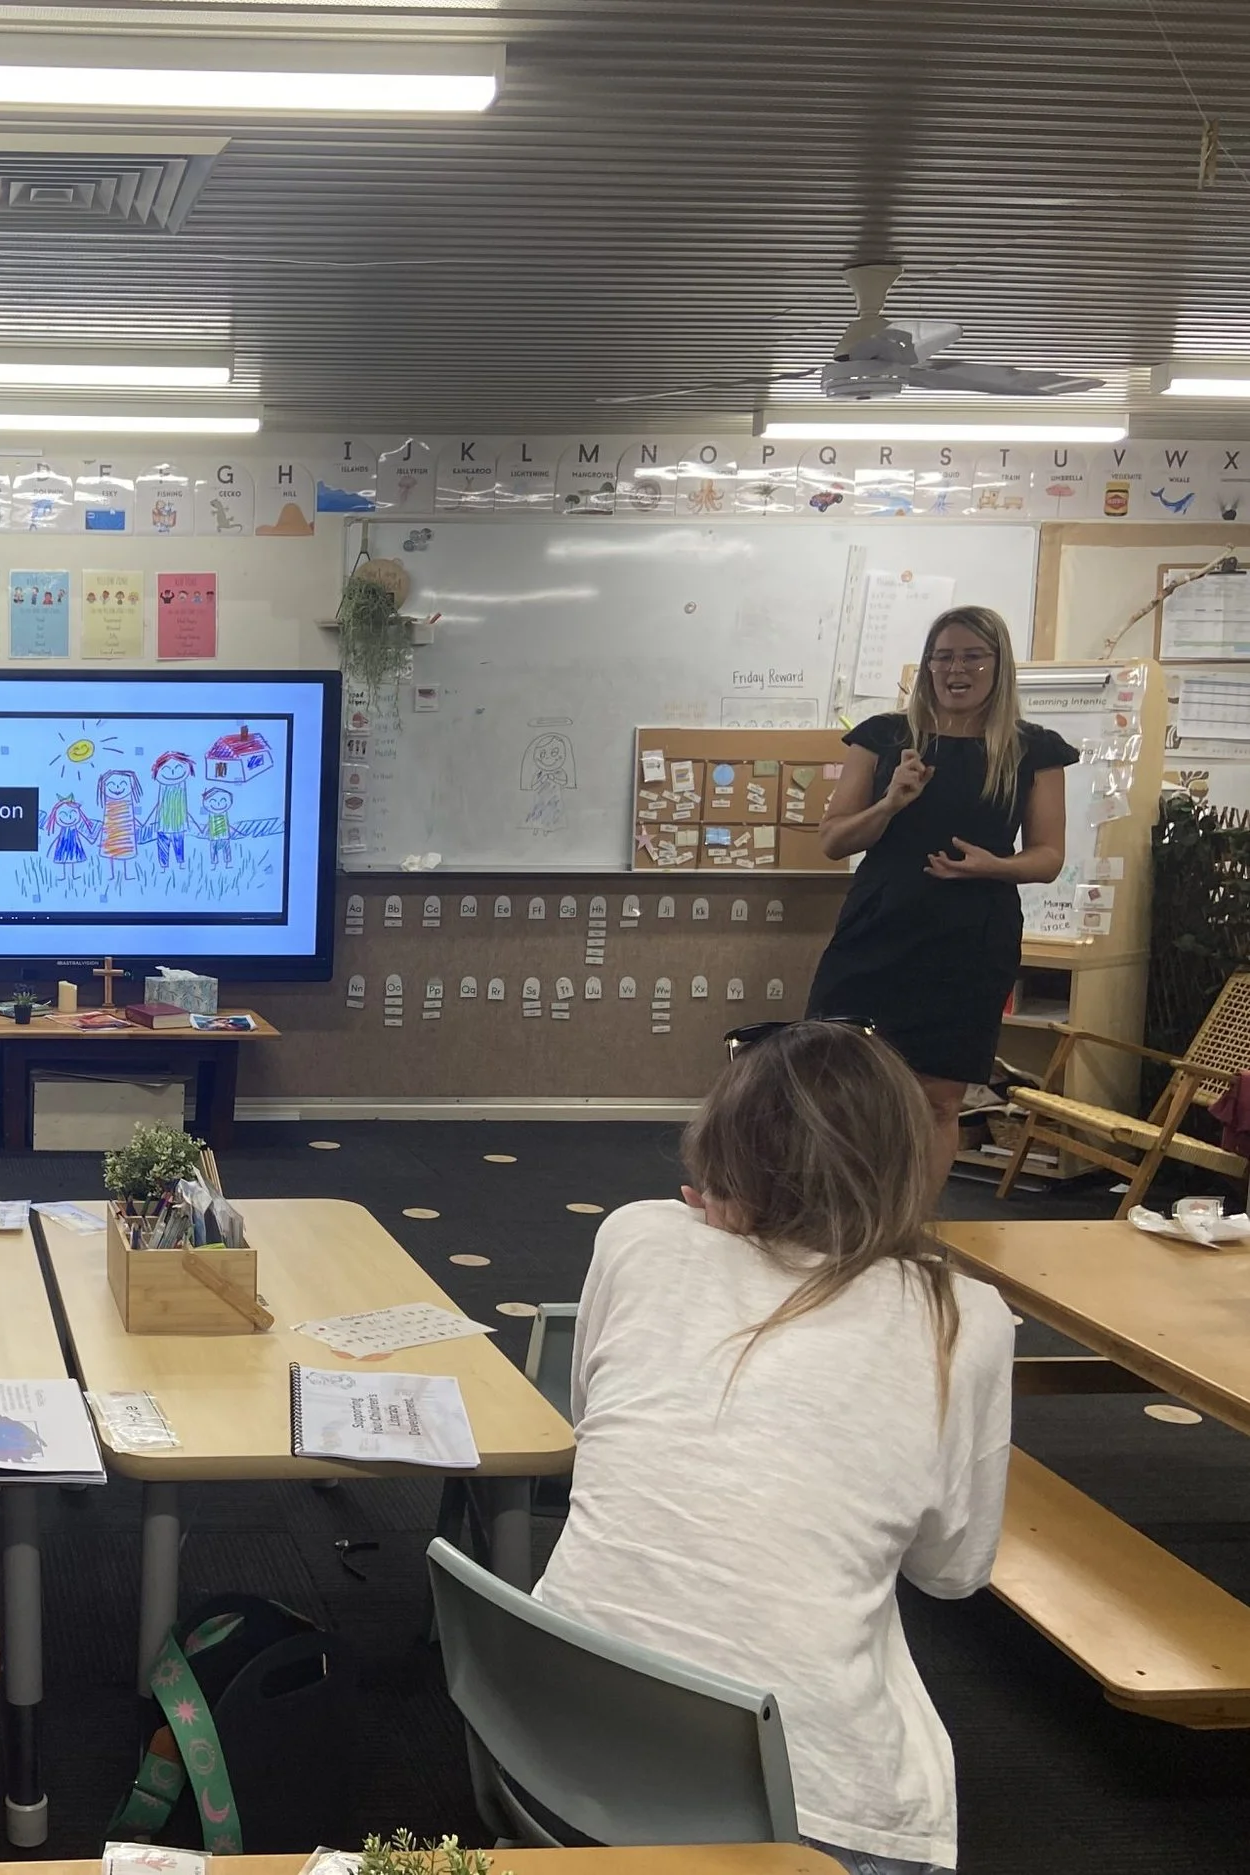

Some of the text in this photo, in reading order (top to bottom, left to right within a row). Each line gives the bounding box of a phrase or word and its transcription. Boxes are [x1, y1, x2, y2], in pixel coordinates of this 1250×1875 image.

[343, 441, 352, 460] I
[402, 442, 412, 461] J
[461, 442, 475, 461] K
[521, 443, 532, 462] L
[578, 444, 599, 463] M
[641, 444, 657, 463] N
[700, 445, 717, 464] O
[762, 445, 775, 464] P
[819, 446, 837, 465] Q
[880, 446, 893, 465] R
[940, 447, 952, 466] S
[999, 448, 1011, 467] T
[1054, 449, 1068, 467] U
[1113, 449, 1126, 467] V
[1165, 450, 1188, 468] W
[1223, 451, 1240, 469] X
[217, 465, 234, 484] G
[278, 465, 293, 484] H
[732, 668, 804, 690] Friday Reward
[1028, 697, 1069, 708] Learning
[349, 904, 362, 913] Aa
[388, 904, 400, 913] Bb
[425, 904, 439, 914] Cc
[462, 904, 476, 913] Dd
[497, 905, 510, 914] Ee
[532, 906, 542, 915] Ff
[561, 905, 576, 916] Gg
[592, 904, 604, 913] Hh
[695, 907, 705, 915] Kk
[1043, 900, 1073, 910] Morgan
[351, 984, 363, 992] Nn
[387, 983, 401, 992] Oo
[429, 985, 441, 995] Pp
[461, 984, 476, 994] Qq
[491, 987, 501, 995] Rr
[526, 986, 537, 995] Ss
[560, 986, 569, 995] Tt
[587, 987, 599, 995] Uu
[694, 985, 705, 993] Xx
[730, 987, 741, 998] Yy
[770, 987, 781, 996] Zz
[351, 1397, 365, 1429] Supporting
[368, 1393, 384, 1435] Your Children's
[387, 1404, 400, 1427] Literacy
